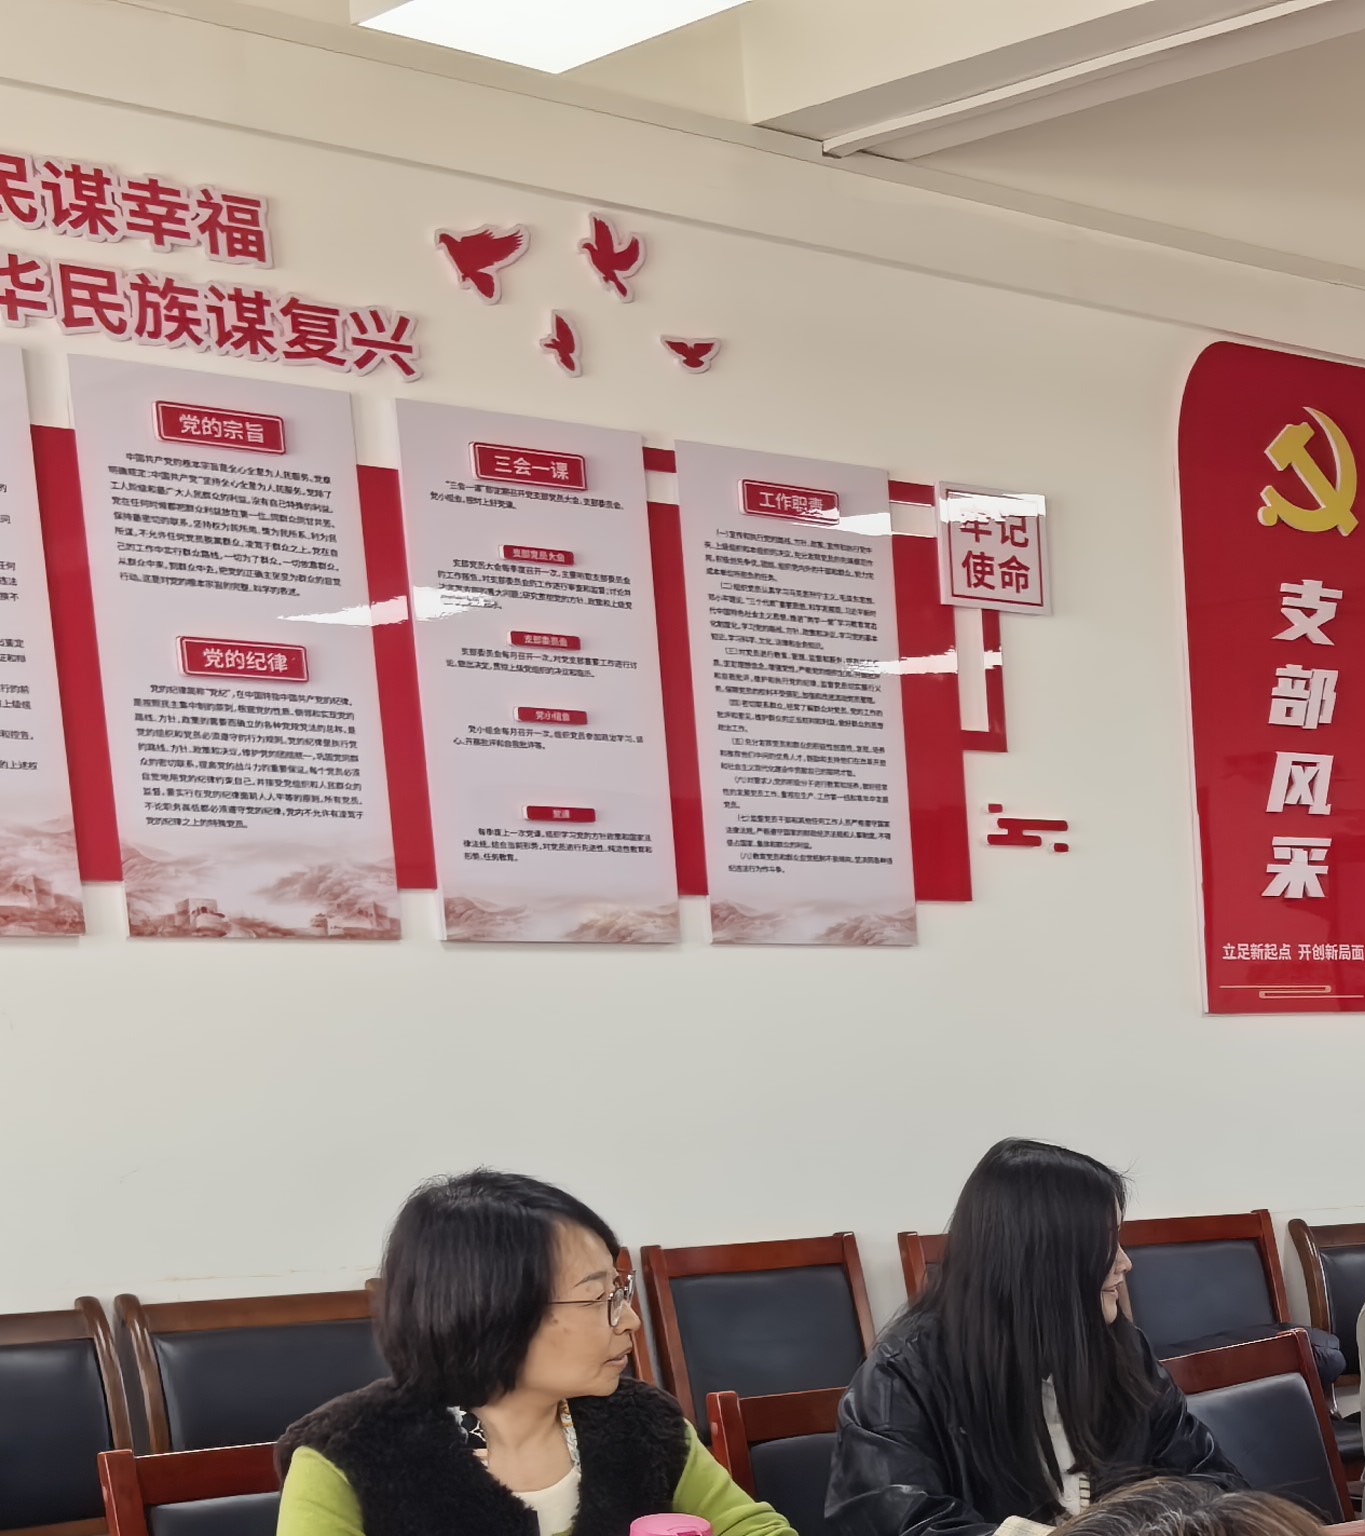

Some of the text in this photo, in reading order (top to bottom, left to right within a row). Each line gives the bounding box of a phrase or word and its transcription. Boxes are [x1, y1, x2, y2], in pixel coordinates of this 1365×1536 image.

[0, 153, 266, 263] 民谋幸福
[0, 252, 413, 376] 华民族谋复兴
[178, 413, 264, 443] 党的宗旨
[494, 454, 569, 480] 三会一课
[760, 491, 824, 512] 工作职责
[961, 550, 1030, 594] 使命
[203, 648, 288, 673] 党的纪律
[1261, 578, 1343, 899] 支部风采
[1222, 942, 1365, 962] 立足新起点 开创新局面
